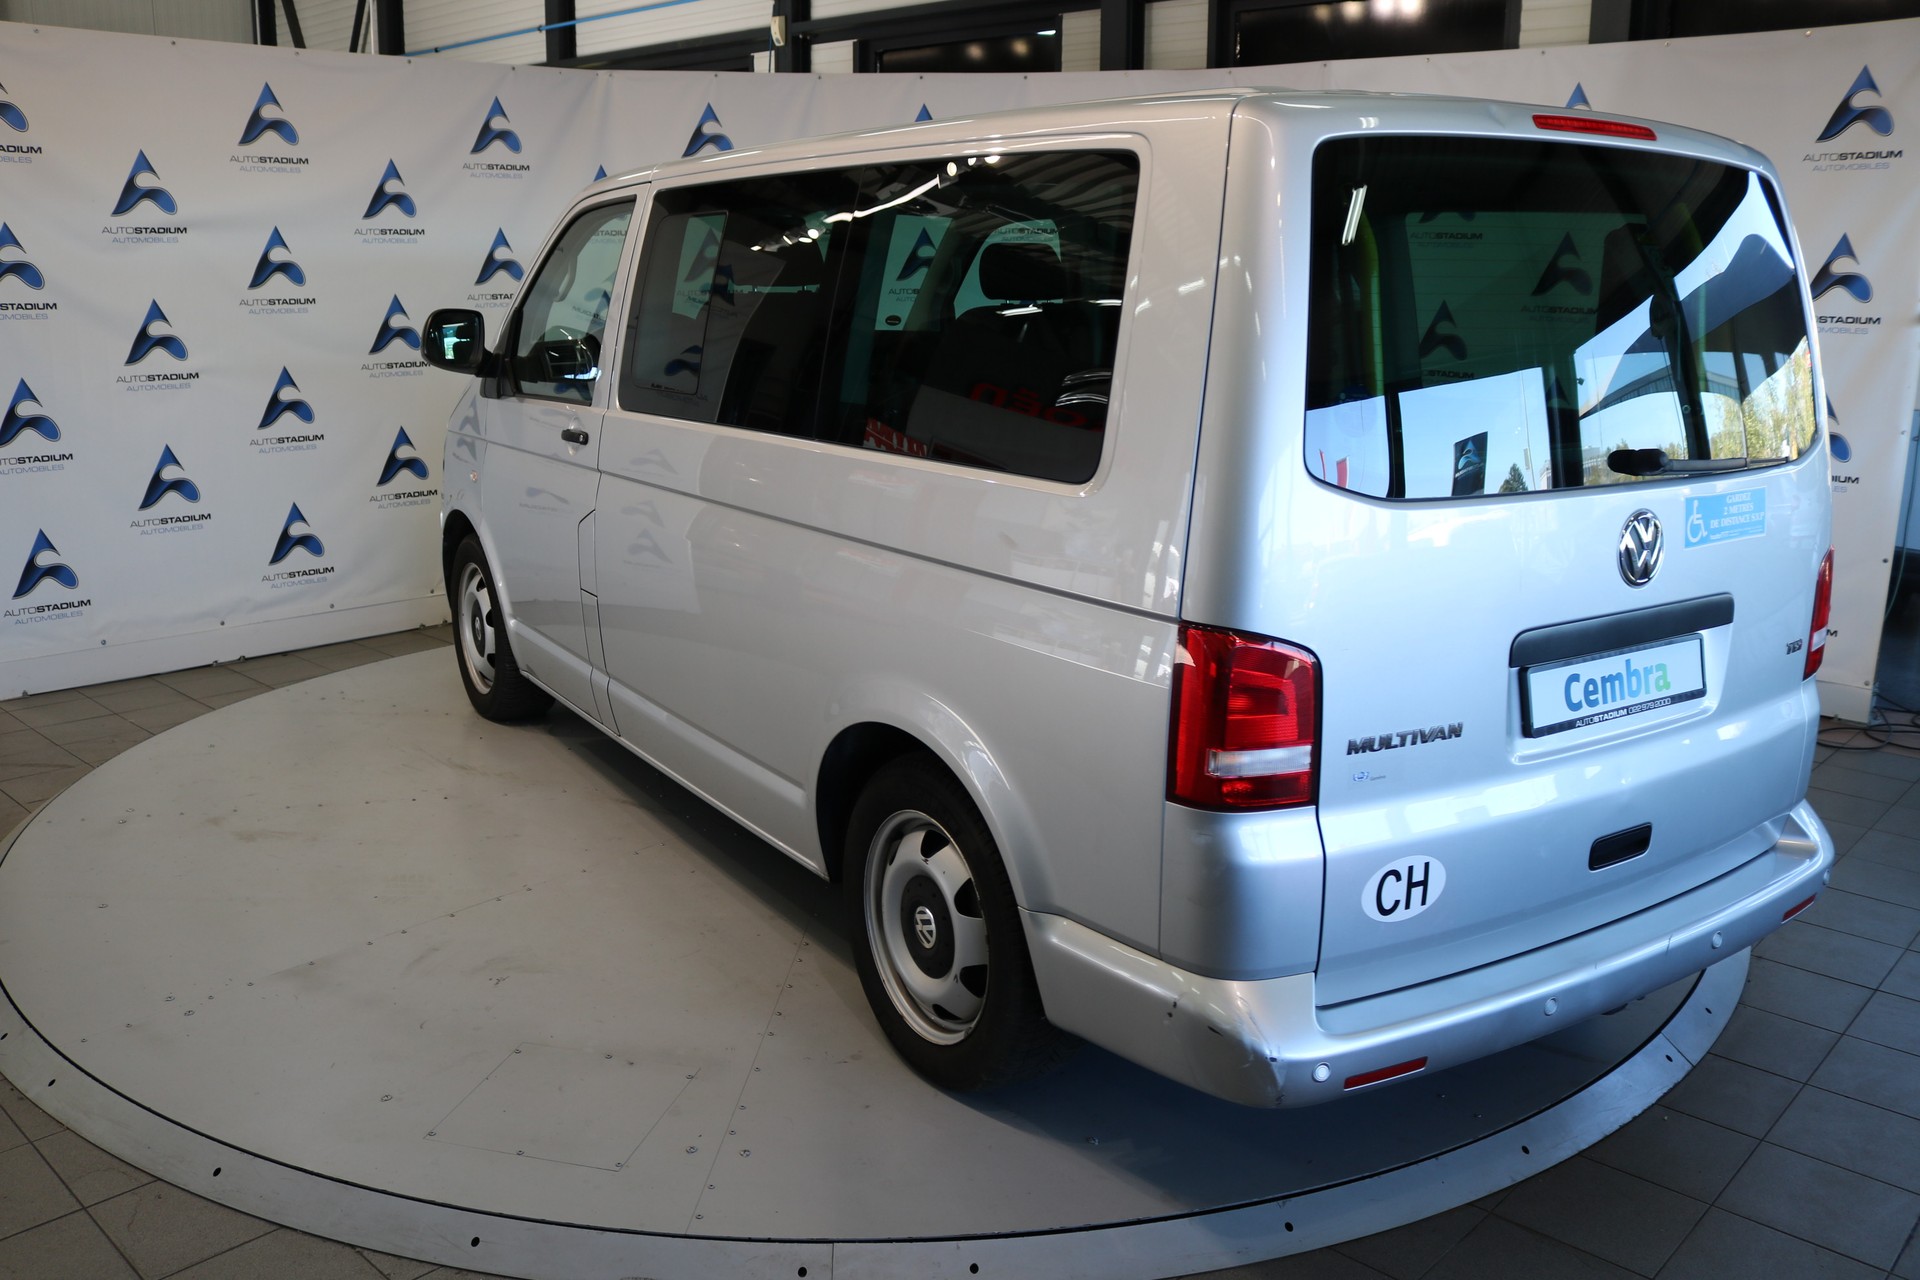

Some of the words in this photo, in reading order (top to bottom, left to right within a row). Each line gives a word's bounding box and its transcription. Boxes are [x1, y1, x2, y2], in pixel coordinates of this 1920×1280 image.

[229, 155, 309, 165] AUTOSTADIUM
[1802, 149, 1903, 162] AUTOSTADIUM
[462, 163, 530, 171] AUTOSTADIUM
[101, 226, 188, 235] AUTOSTADIUM
[353, 227, 425, 236] AUTOSTADIUM
[0, 302, 57, 311] STADIUM
[239, 297, 316, 307] AUTOSTADIUM
[1817, 315, 1881, 325] STADIUM
[116, 372, 200, 384] AUTOSTADIUM
[249, 434, 324, 446] AUTOSTADIUM
[0, 453, 73, 466] TOSTADIUM
[369, 489, 438, 503] AUTOSTADIUM
[130, 513, 212, 528] AUTOSTADIUM
[1710, 519, 1720, 529] DE
[261, 566, 335, 582] AUTOSTADIUM
[3, 599, 91, 618] AUTOSTADIUM
[1564, 658, 1671, 712] Cembra
[1575, 708, 1628, 727] AUTOSTADIUM
[1346, 721, 1464, 755] MULTIVAN
[1376, 861, 1430, 916] CH
